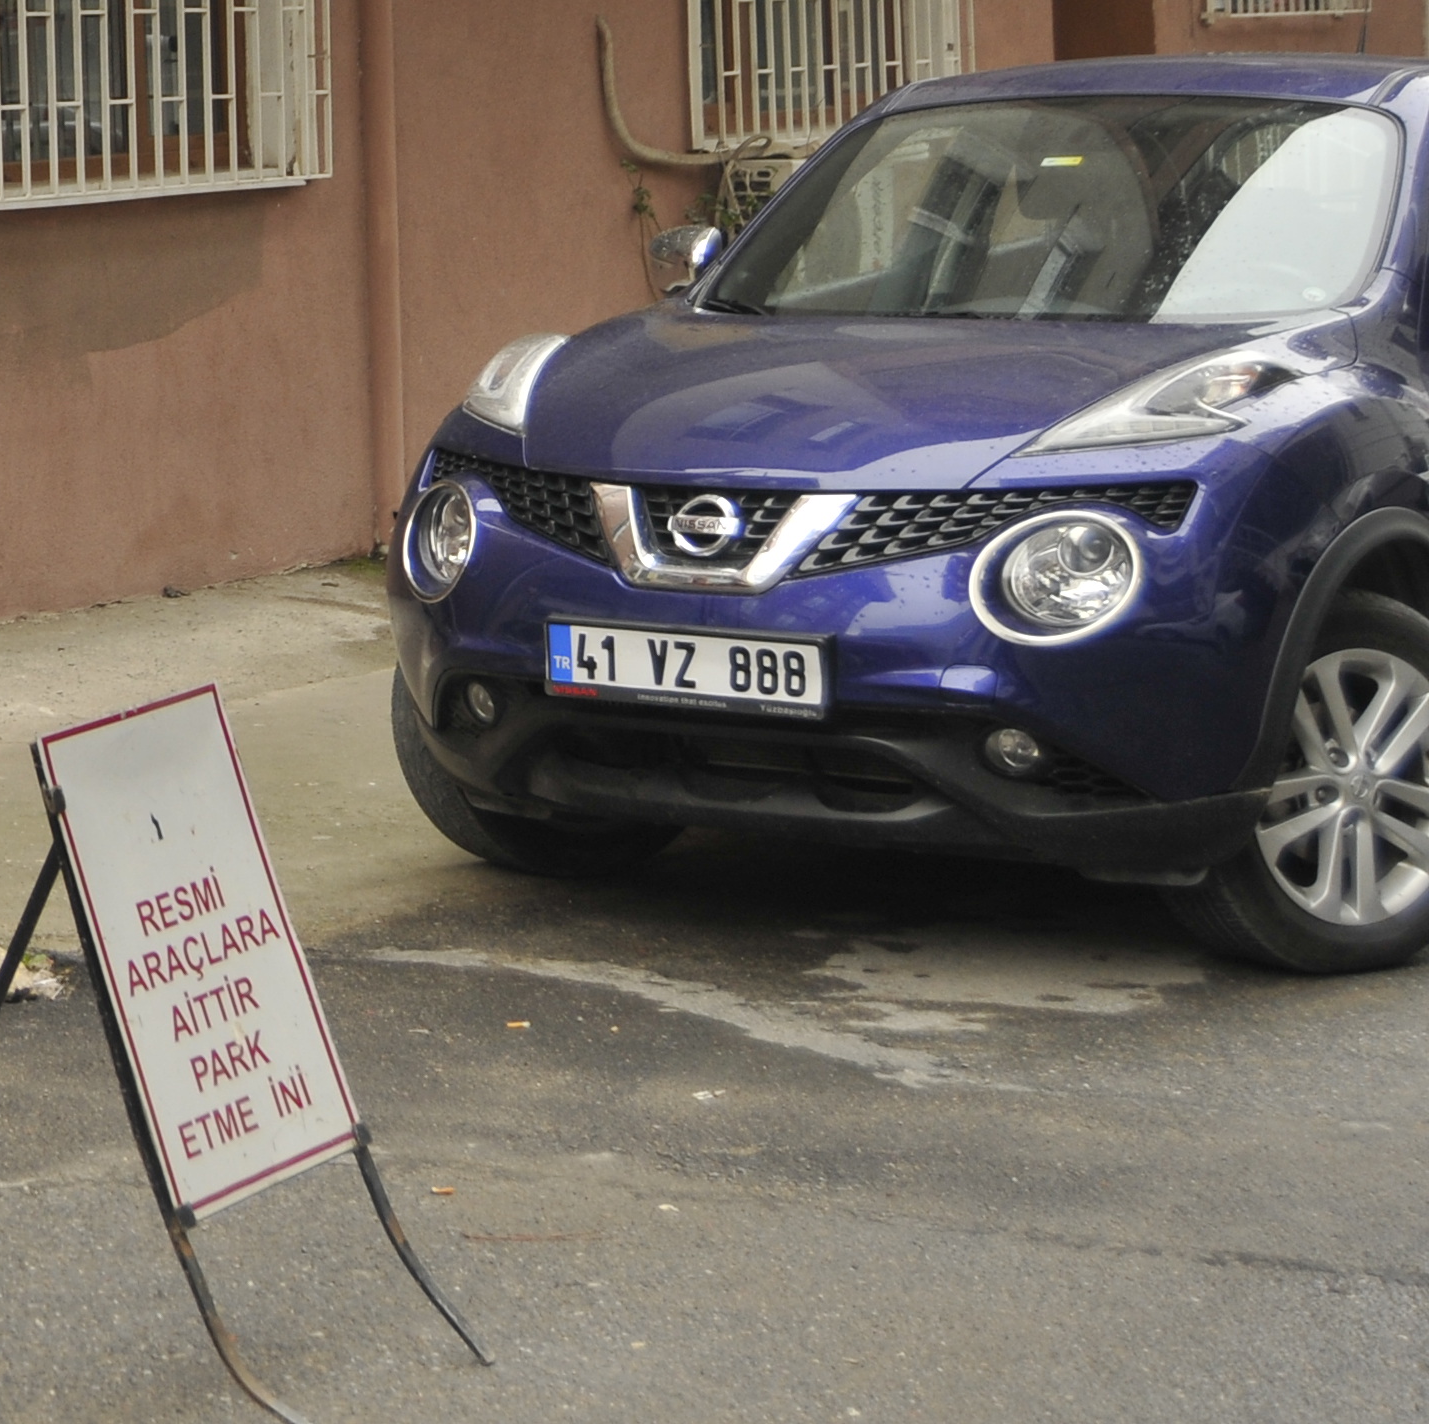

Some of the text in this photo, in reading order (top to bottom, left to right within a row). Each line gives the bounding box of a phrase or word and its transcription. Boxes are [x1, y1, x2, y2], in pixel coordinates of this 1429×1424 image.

[676, 518, 727, 530] NISSAN
[553, 655, 571, 670] TR
[577, 633, 806, 697] 41 VZ 888
[136, 865, 226, 937] RESMİ
[127, 908, 280, 997] ARAÇLARA
[172, 975, 260, 1042] AİTTİR
[190, 1029, 271, 1093] PARK
